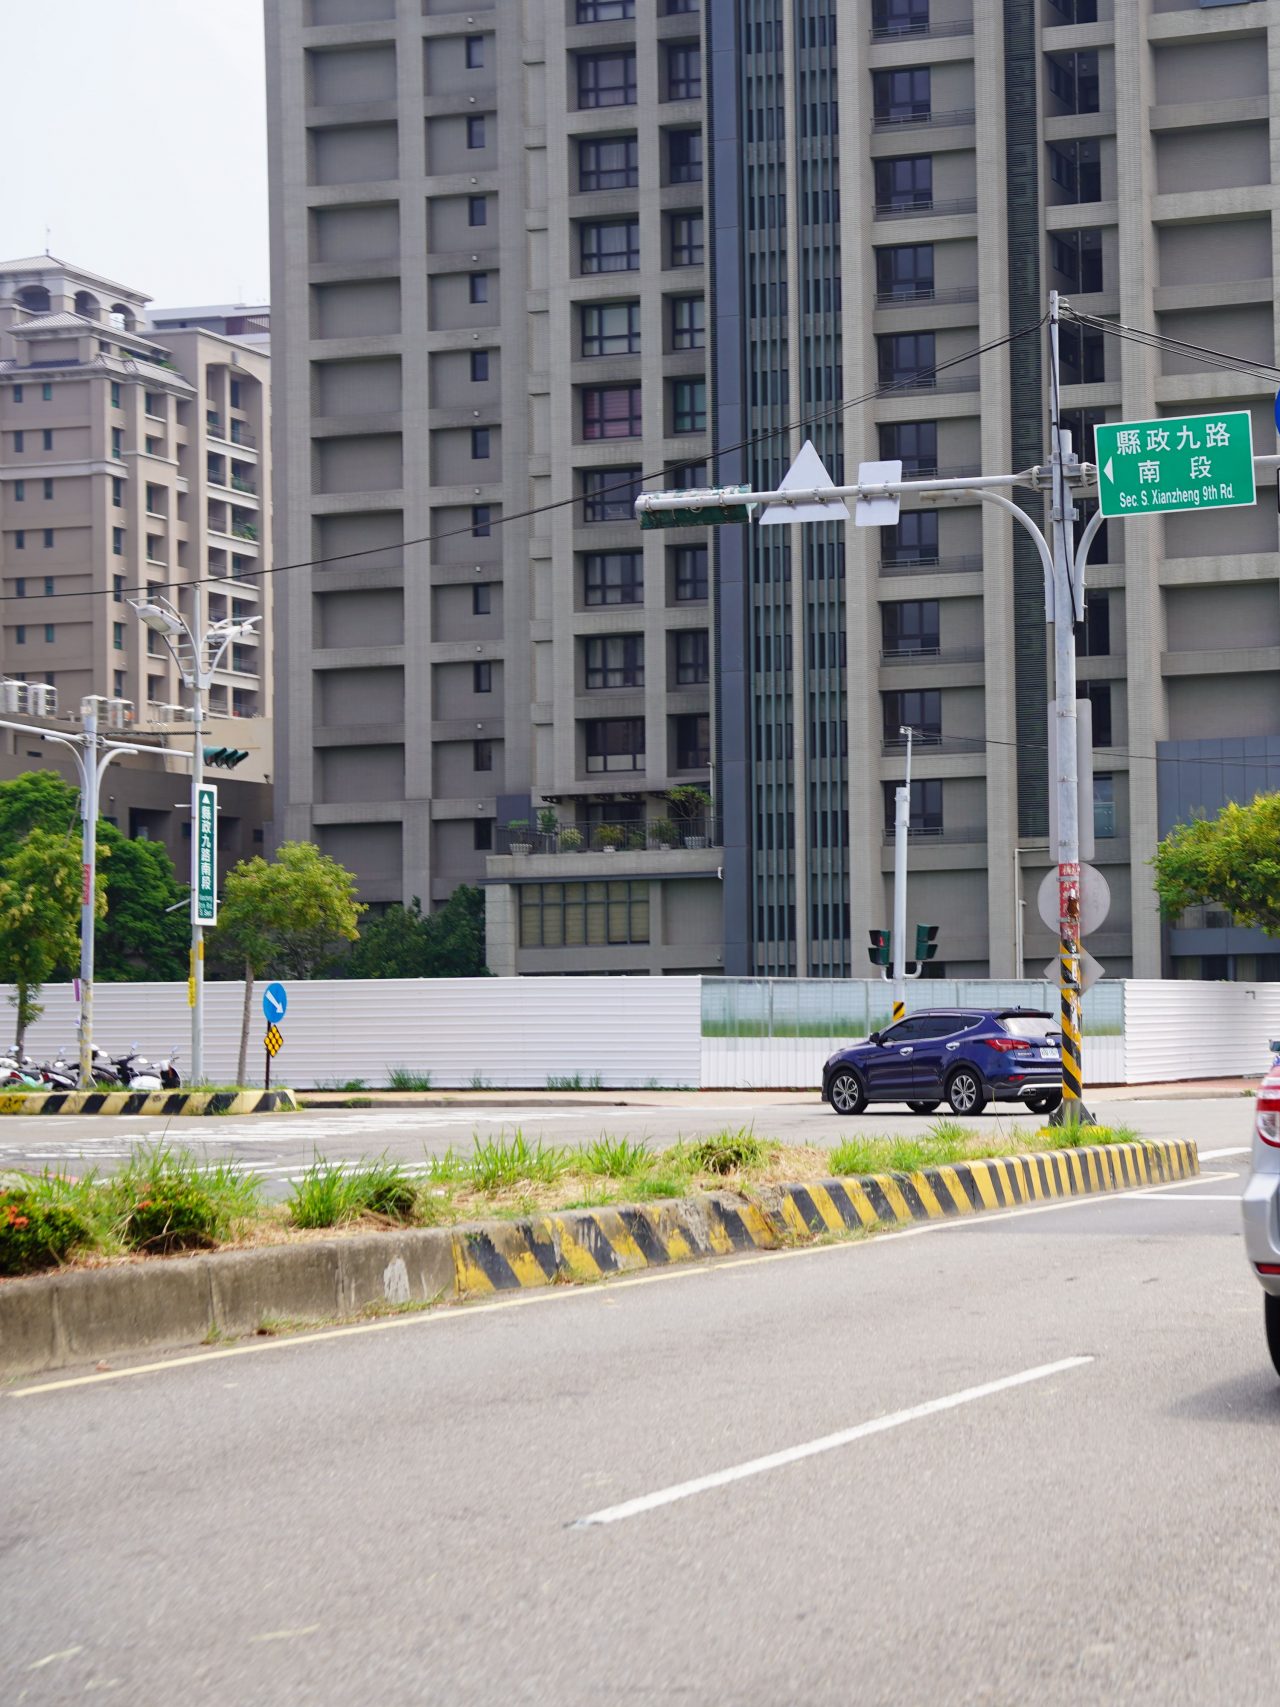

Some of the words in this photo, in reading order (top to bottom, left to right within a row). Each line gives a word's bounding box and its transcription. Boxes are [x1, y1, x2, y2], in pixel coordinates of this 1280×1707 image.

[1116, 421, 1231, 456] 縣政九路
[1138, 455, 1212, 484] 南段
[1119, 491, 1139, 508] Sec.
[1141, 490, 1150, 506] S.
[1152, 487, 1200, 506] Xianzheng
[1202, 485, 1218, 501] 9th
[1220, 483, 1236, 499] Rd.
[201, 805, 212, 890] 縣政九路南段
